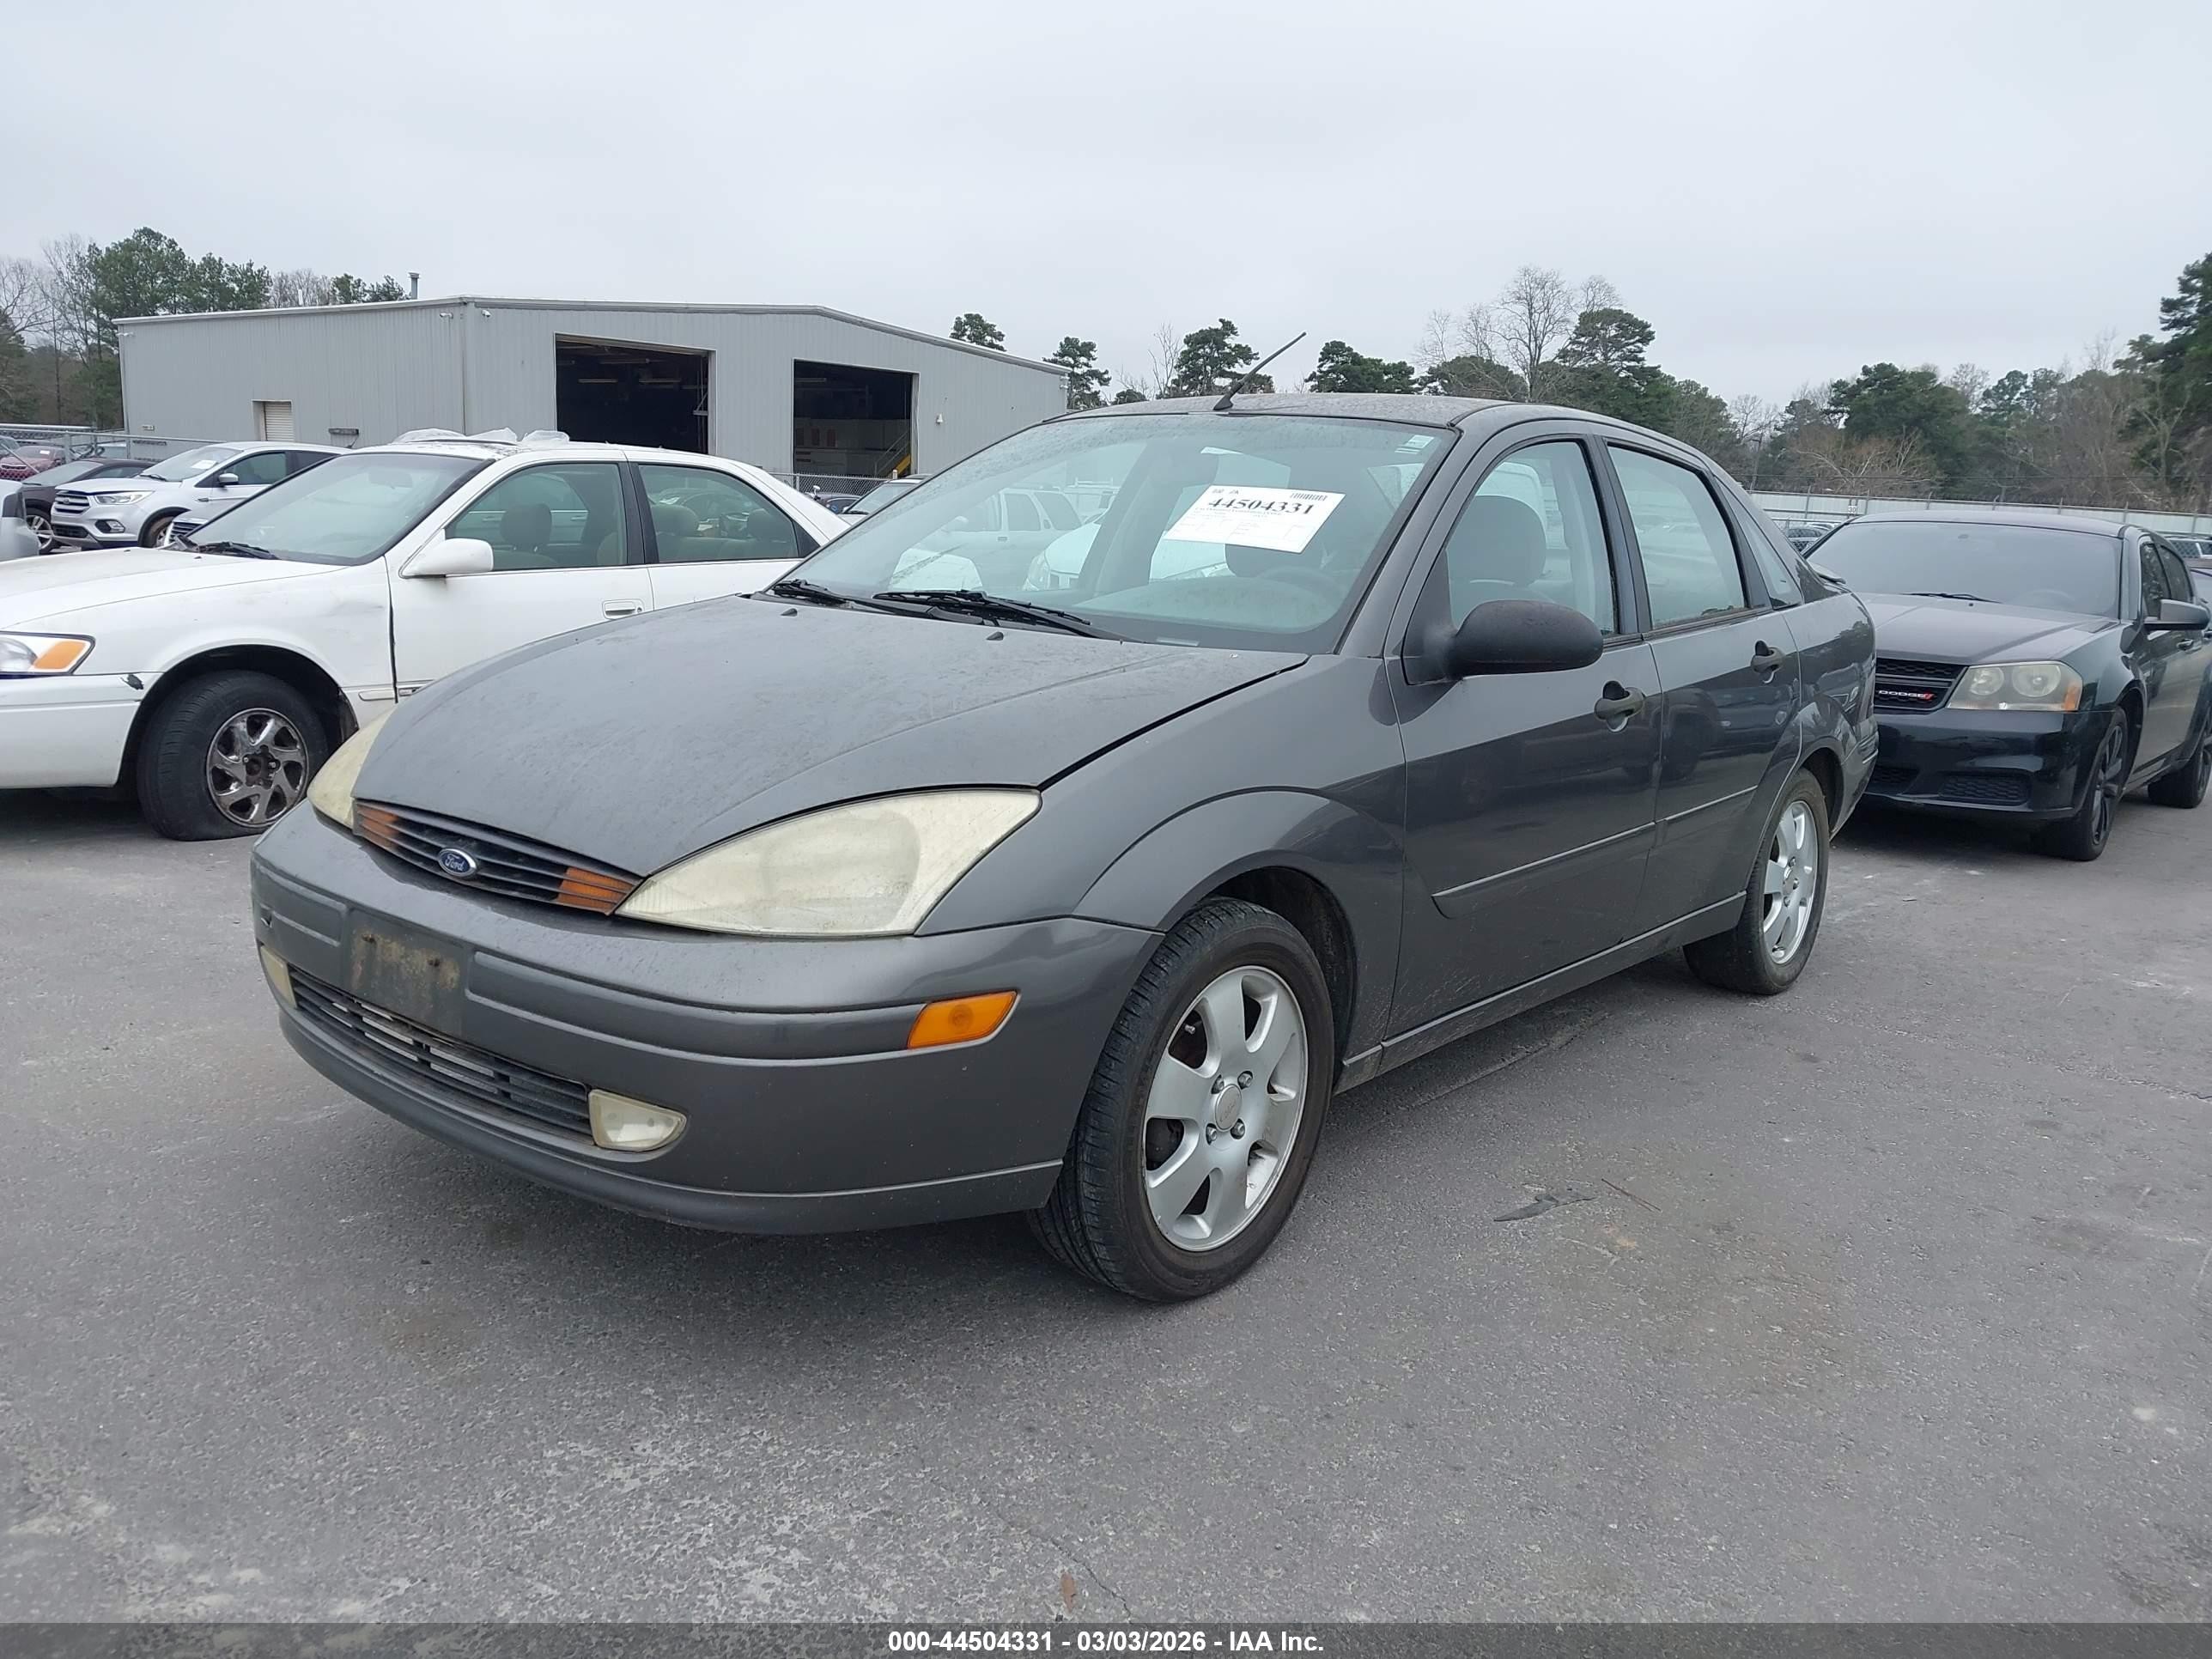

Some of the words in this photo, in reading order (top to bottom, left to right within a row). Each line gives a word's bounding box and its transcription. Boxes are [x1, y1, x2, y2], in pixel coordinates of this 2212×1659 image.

[1208, 497, 1315, 515] 44504331
[1878, 690, 1924, 699] DODGE
[444, 853, 466, 872] Ford
